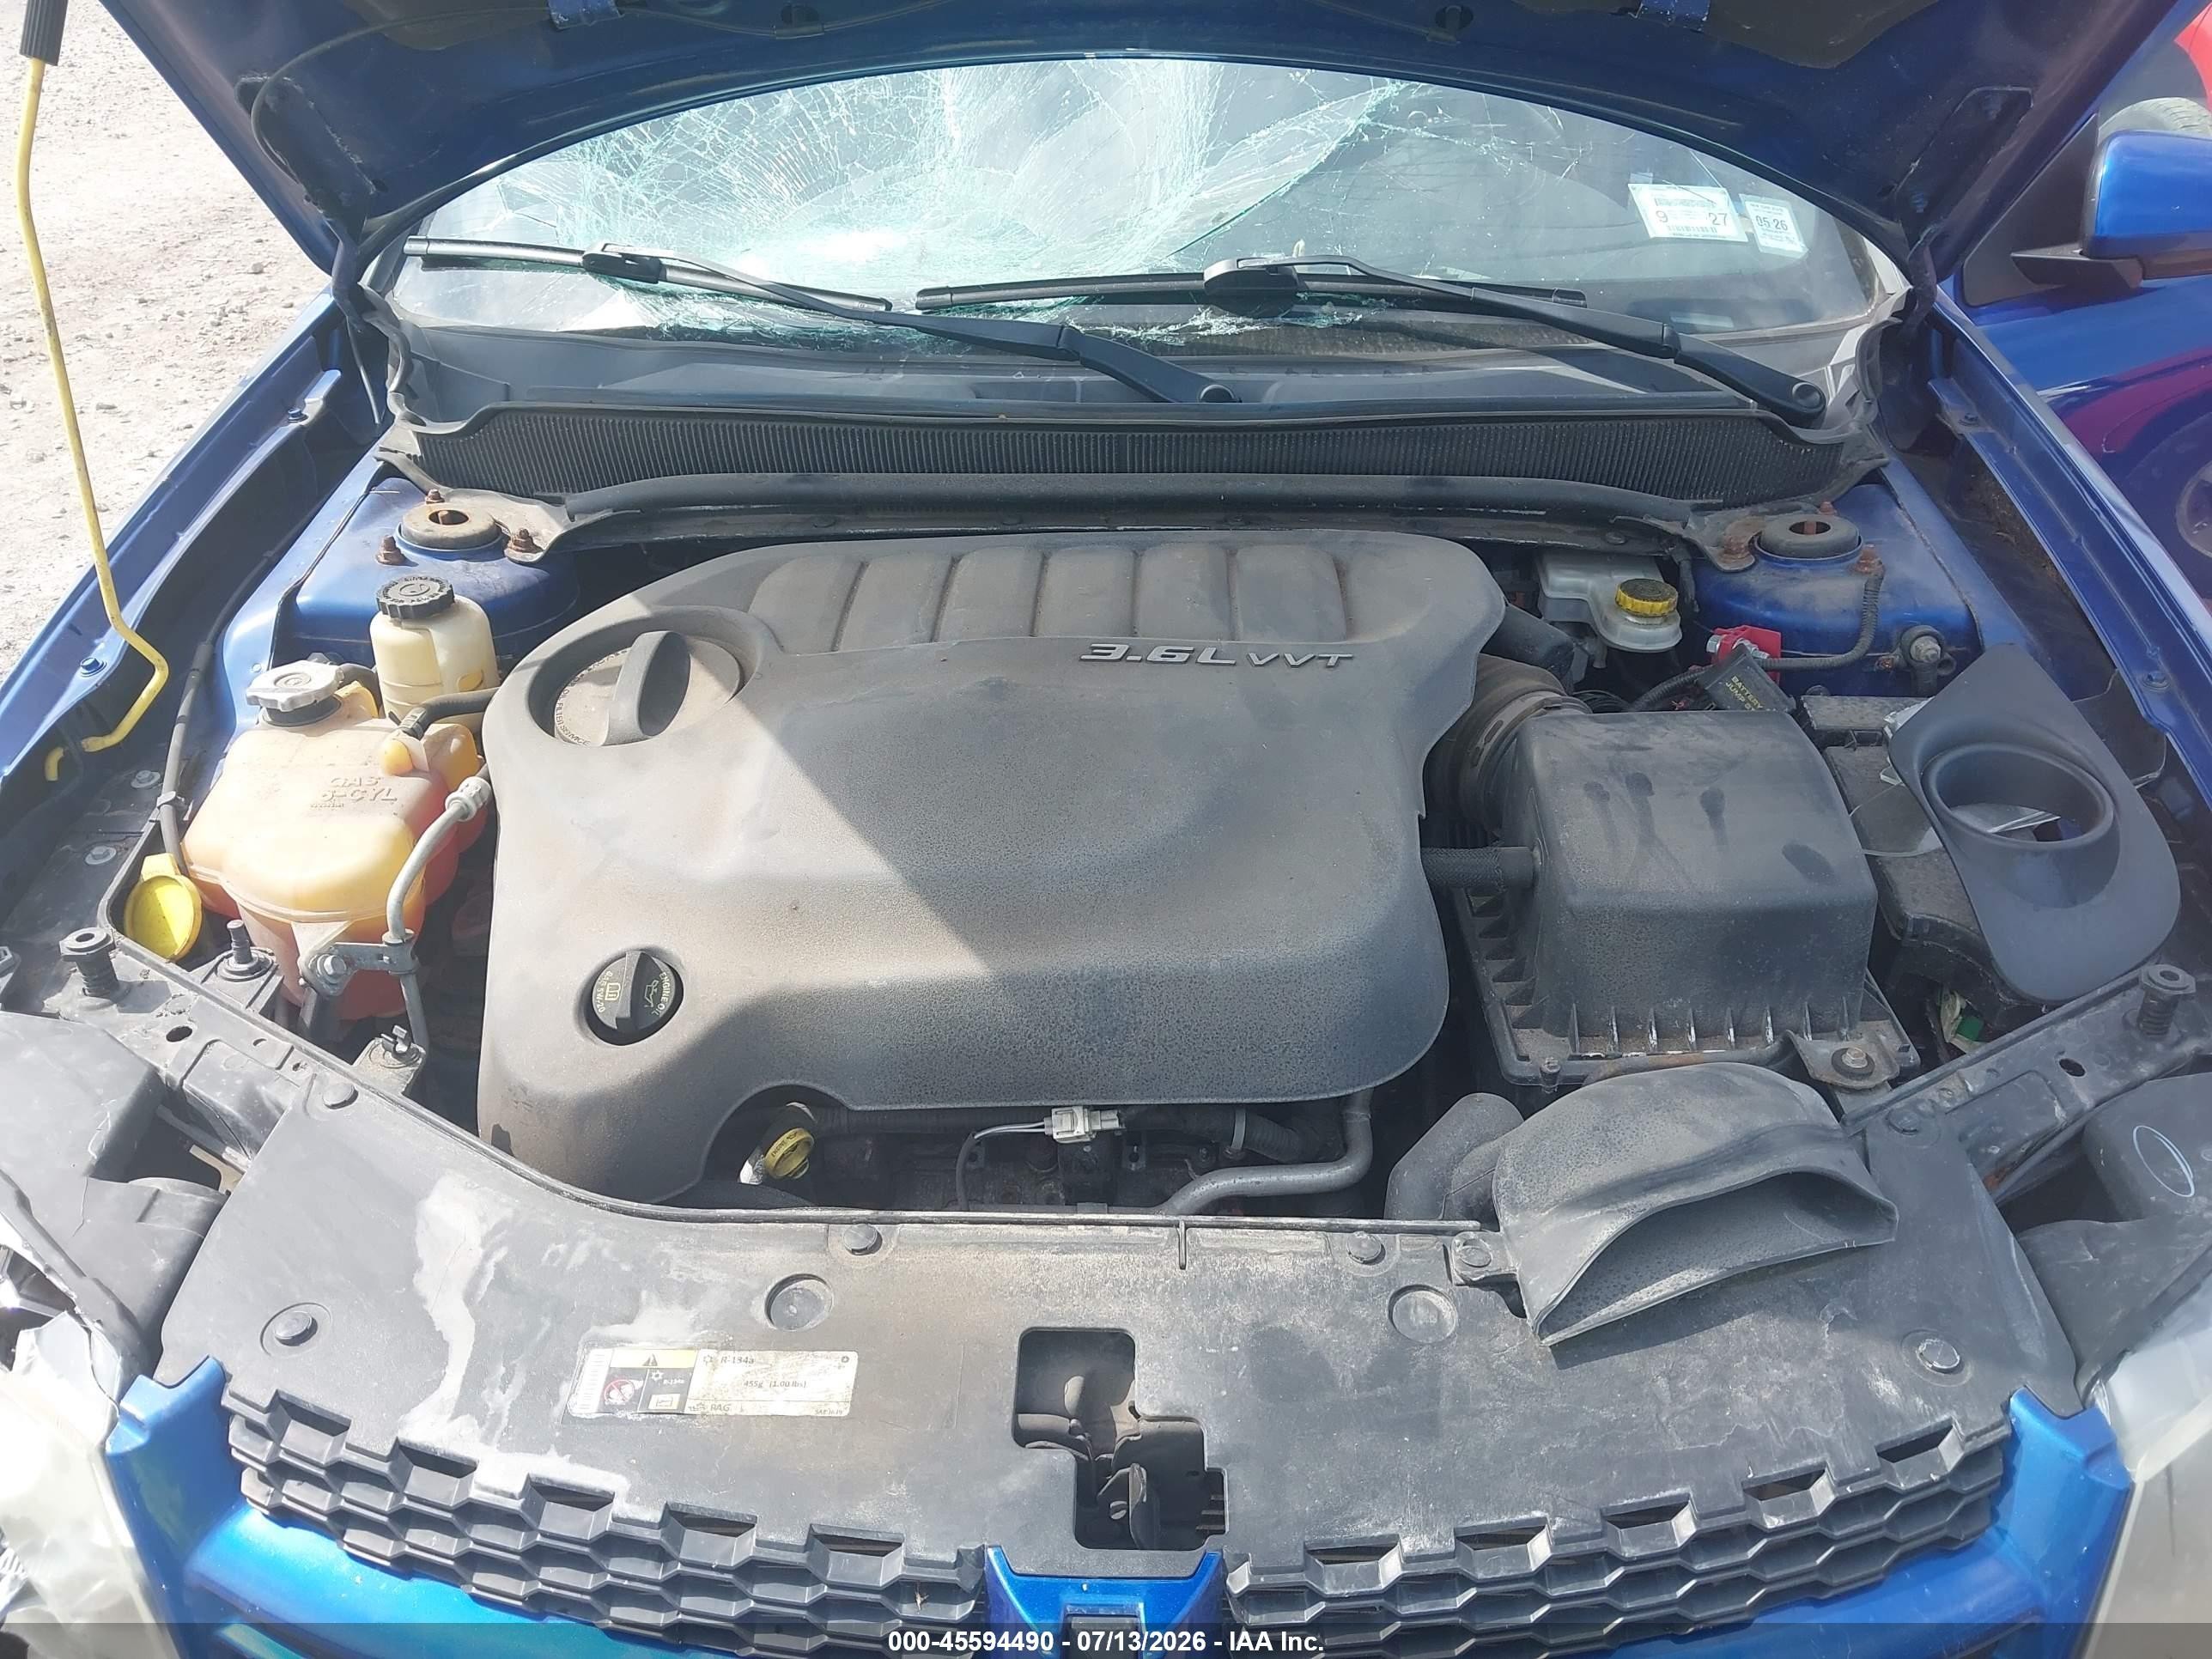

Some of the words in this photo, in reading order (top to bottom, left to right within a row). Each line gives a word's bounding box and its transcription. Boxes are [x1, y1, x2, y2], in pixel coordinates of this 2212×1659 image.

[1655, 210, 1668, 223] 9
[1707, 211, 1729, 227] 27
[1772, 218, 1789, 231] 26
[1079, 643, 1237, 665] 3.6L
[1247, 652, 1354, 668] VVT
[1725, 681, 1746, 702] JUMP
[1731, 676, 1764, 708] BATTERY
[659, 971, 671, 1003] ENGINE
[651, 1003, 665, 1016] OIL
